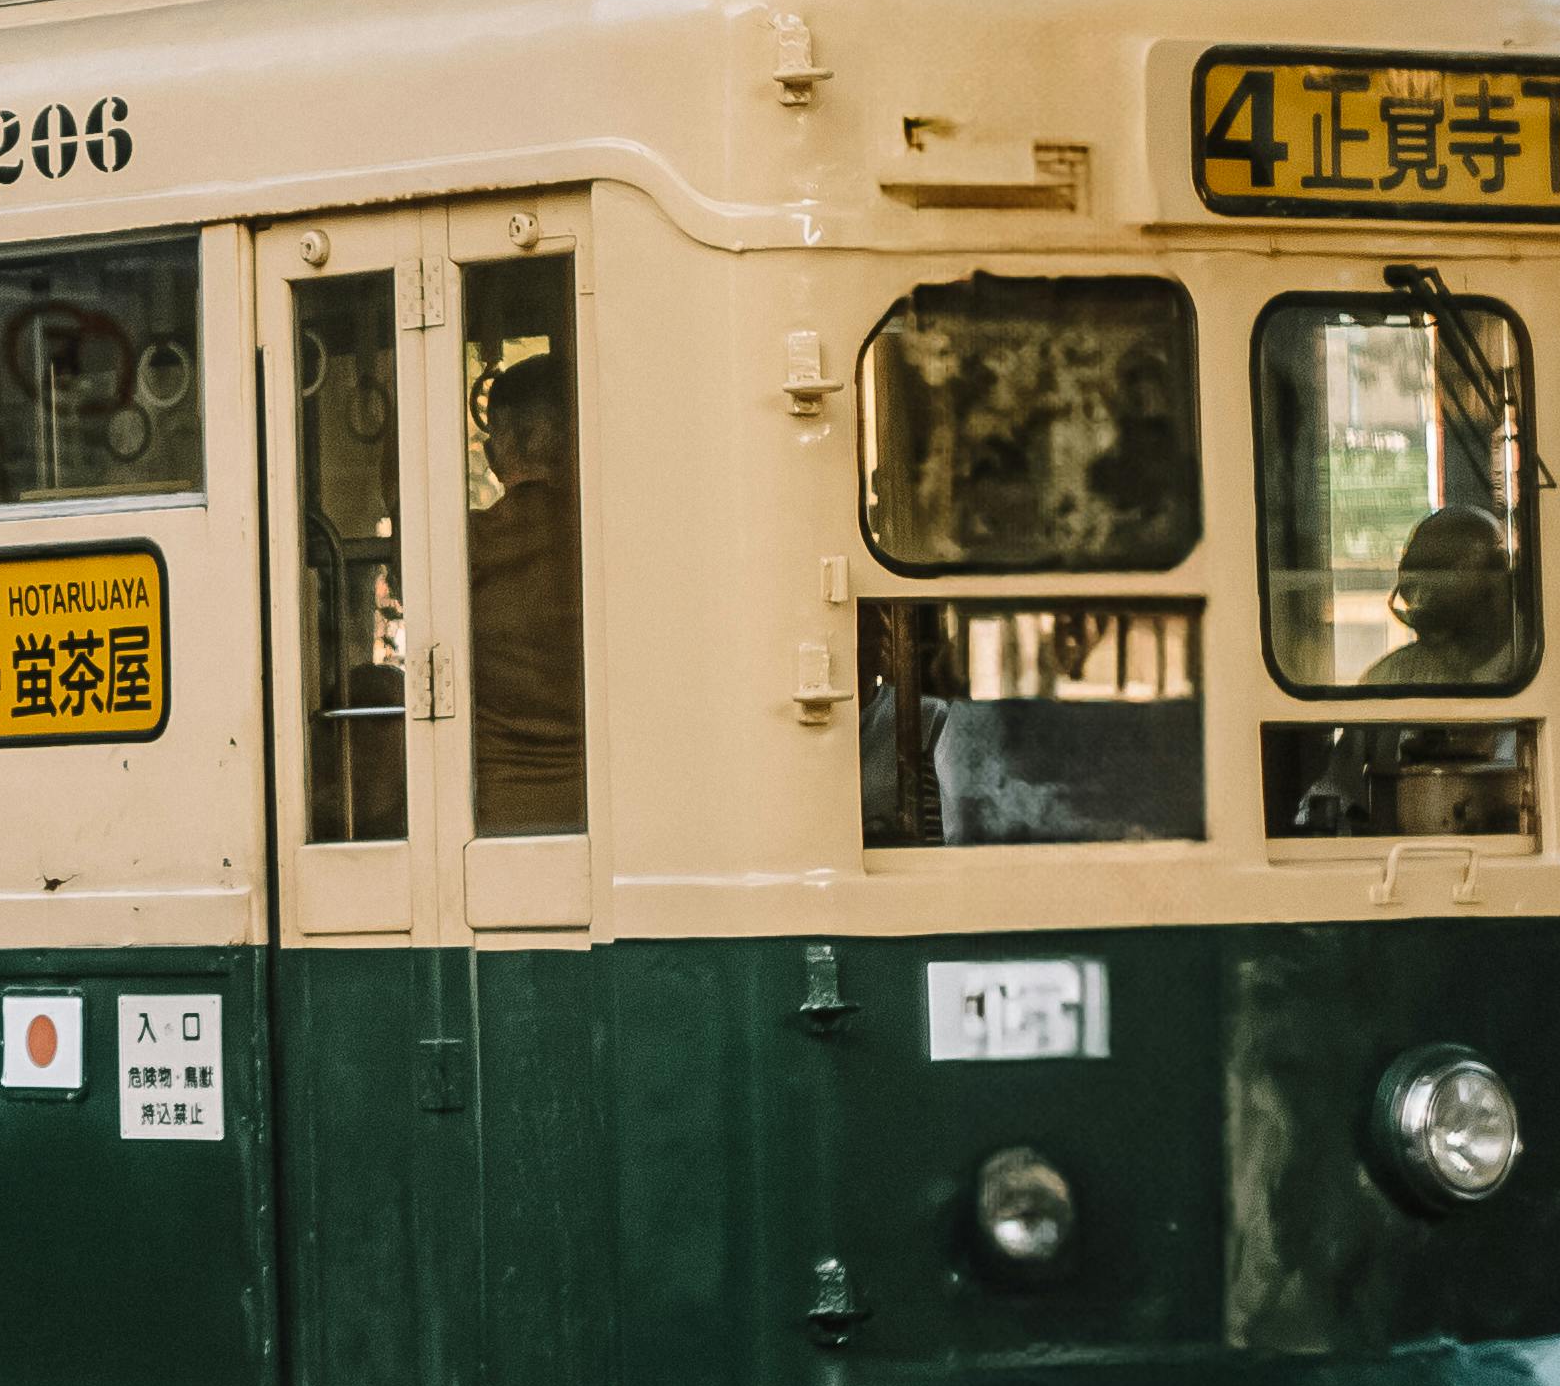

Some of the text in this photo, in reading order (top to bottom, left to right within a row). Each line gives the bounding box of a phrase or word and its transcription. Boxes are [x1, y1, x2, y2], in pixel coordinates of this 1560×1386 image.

[1205, 69, 1288, 188] 4
[8, 576, 151, 618] HOTARUJAYA
[10, 625, 152, 719] 蛍茶屋
[136, 1012, 201, 1044] 入口
[140, 1102, 206, 1127] 持込禁止
